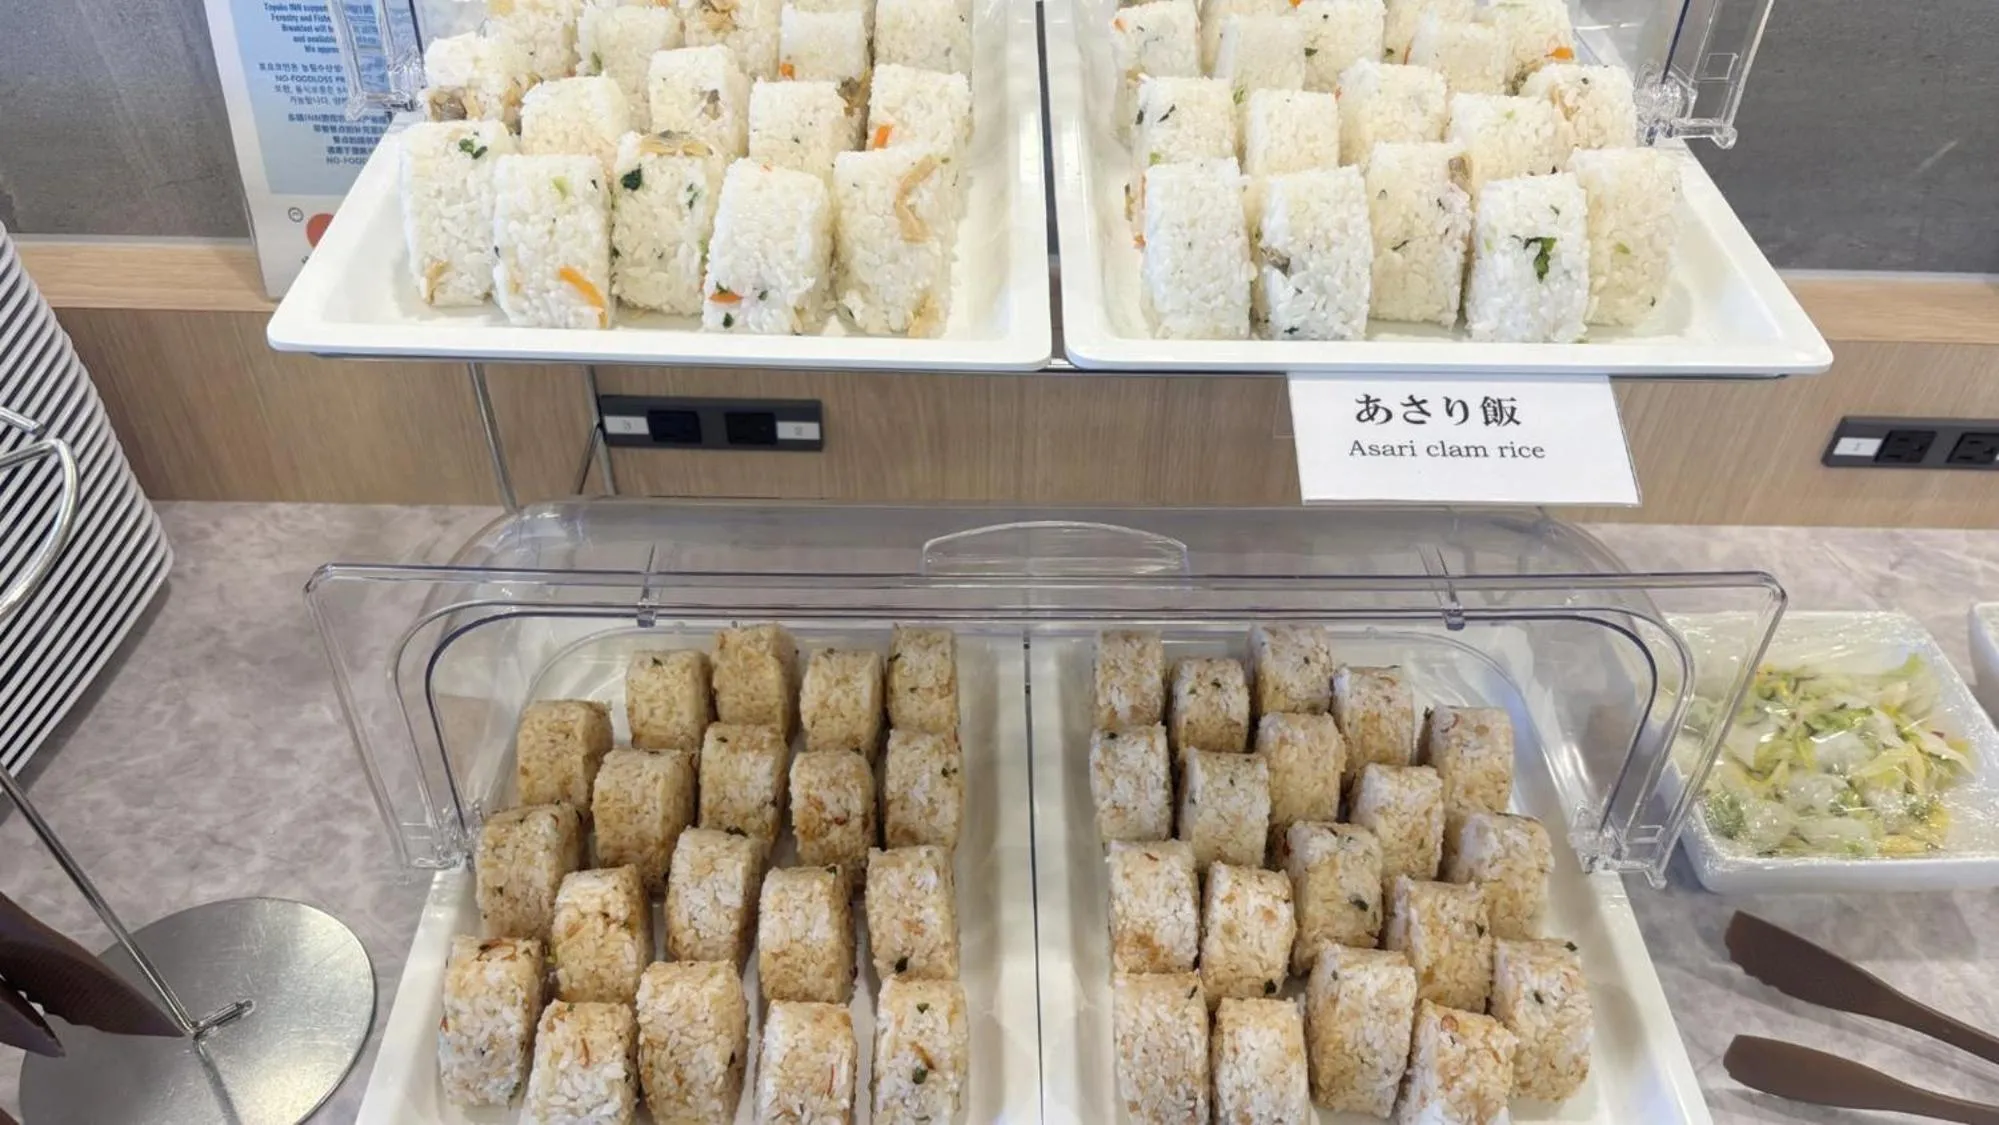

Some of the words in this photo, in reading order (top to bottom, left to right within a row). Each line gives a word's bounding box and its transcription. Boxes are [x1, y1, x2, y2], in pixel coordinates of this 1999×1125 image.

[271, 13, 298, 23] Forestry
[282, 24, 313, 32] Breakfast
[315, 24, 327, 32] will
[1355, 393, 1522, 427] あさり飯
[1349, 440, 1417, 458] Asari
[1426, 440, 1489, 458] clam
[1499, 441, 1546, 459] rice
